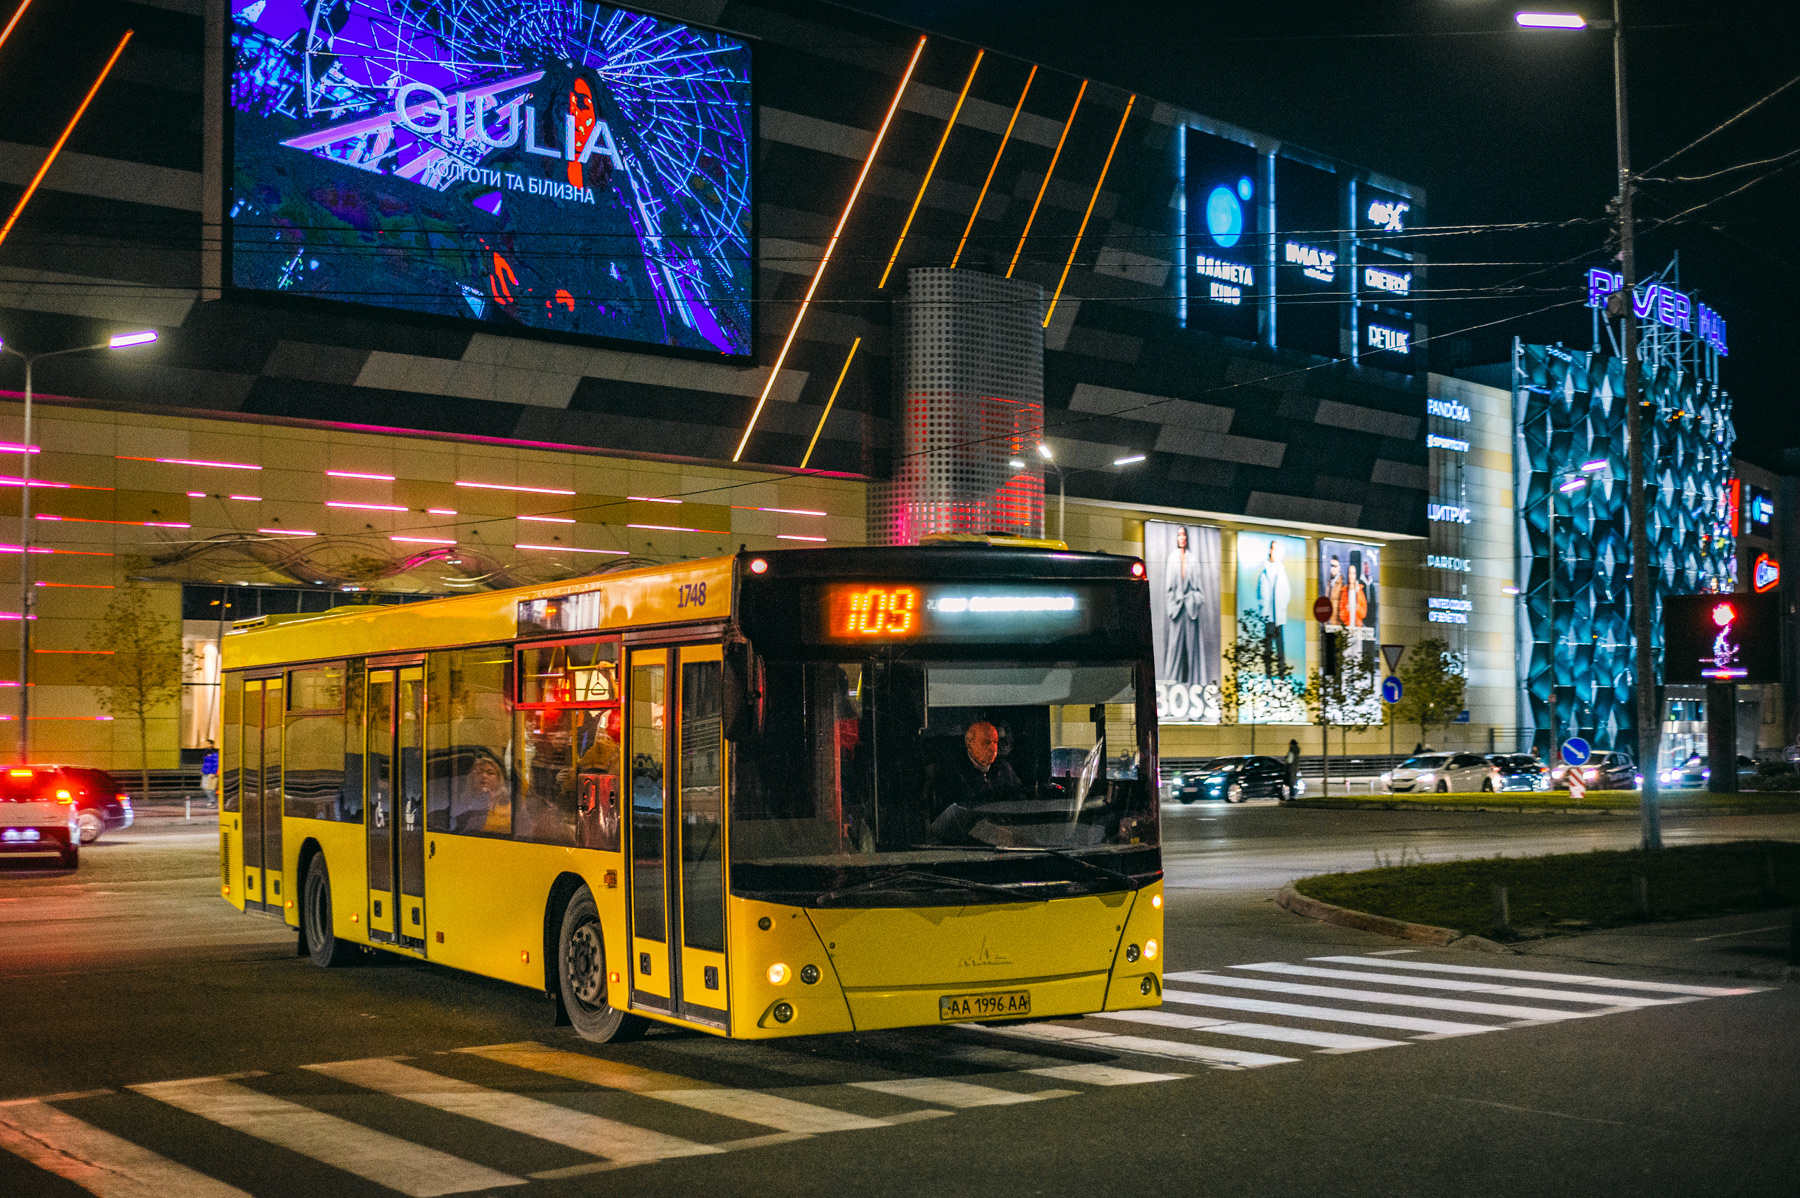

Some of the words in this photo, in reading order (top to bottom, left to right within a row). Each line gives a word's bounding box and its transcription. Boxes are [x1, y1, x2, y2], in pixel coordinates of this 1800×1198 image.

[395, 81, 625, 171] GIULIA
[426, 158, 501, 188] КОЛГОТИ
[505, 173, 525, 192] ТА
[529, 176, 596, 205] БІЛИЗНА
[678, 581, 706, 608] 1748
[848, 589, 914, 633] 109
[1156, 683, 1220, 718] BOSS
[951, 1000, 971, 1015] AA
[974, 996, 1004, 1013] 1996
[1008, 995, 1027, 1011] AA
